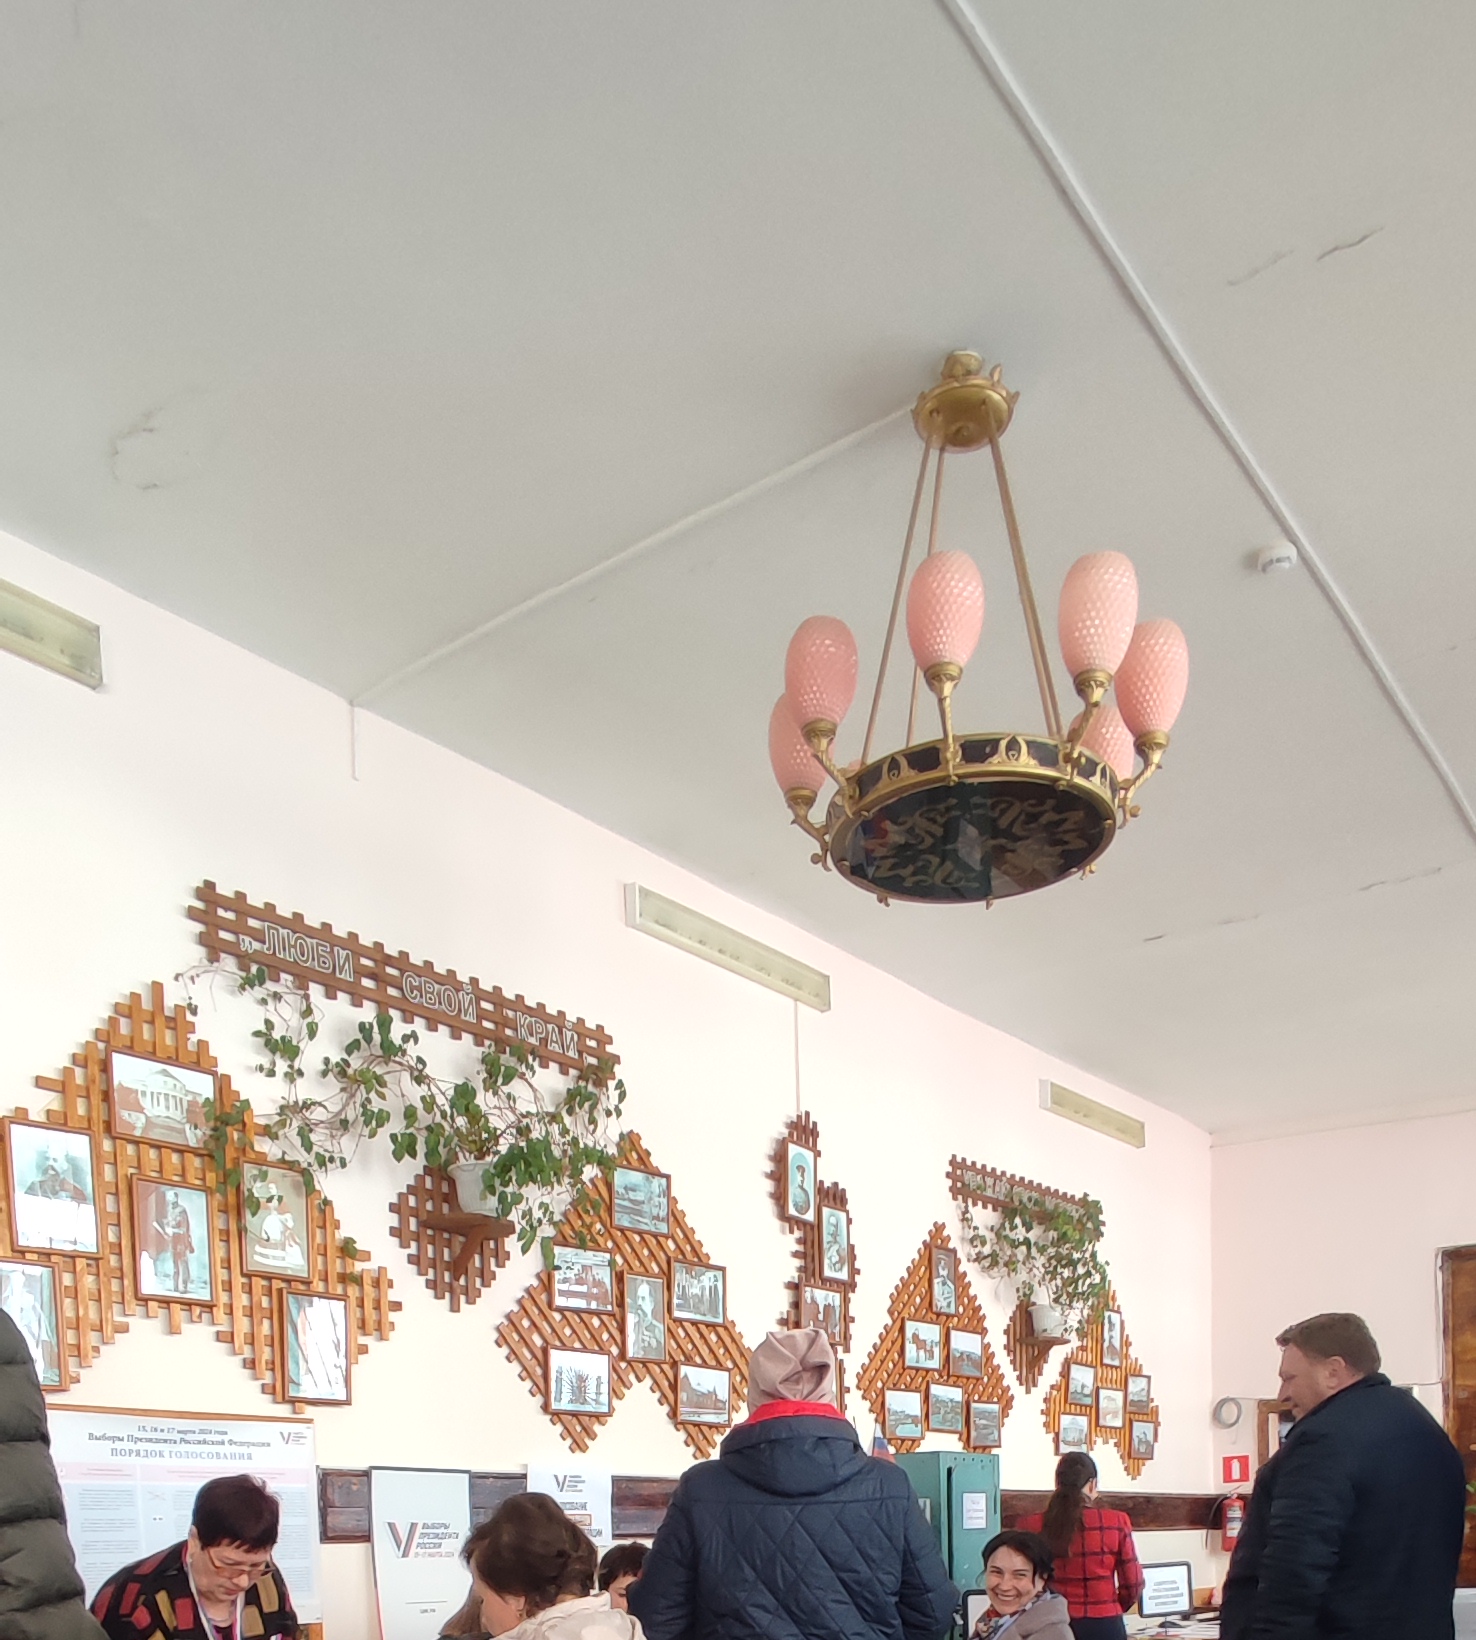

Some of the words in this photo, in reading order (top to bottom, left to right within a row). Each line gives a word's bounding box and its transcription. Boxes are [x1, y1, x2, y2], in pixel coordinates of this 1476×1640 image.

[403, 972, 477, 1023] СВОЙ
[88, 1433, 124, 1444] Выборы
[127, 1434, 178, 1445] Президента
[110, 1448, 165, 1459] ПОРЯДОК
[169, 1450, 253, 1461] ГОЛОСОВАНИЯ
